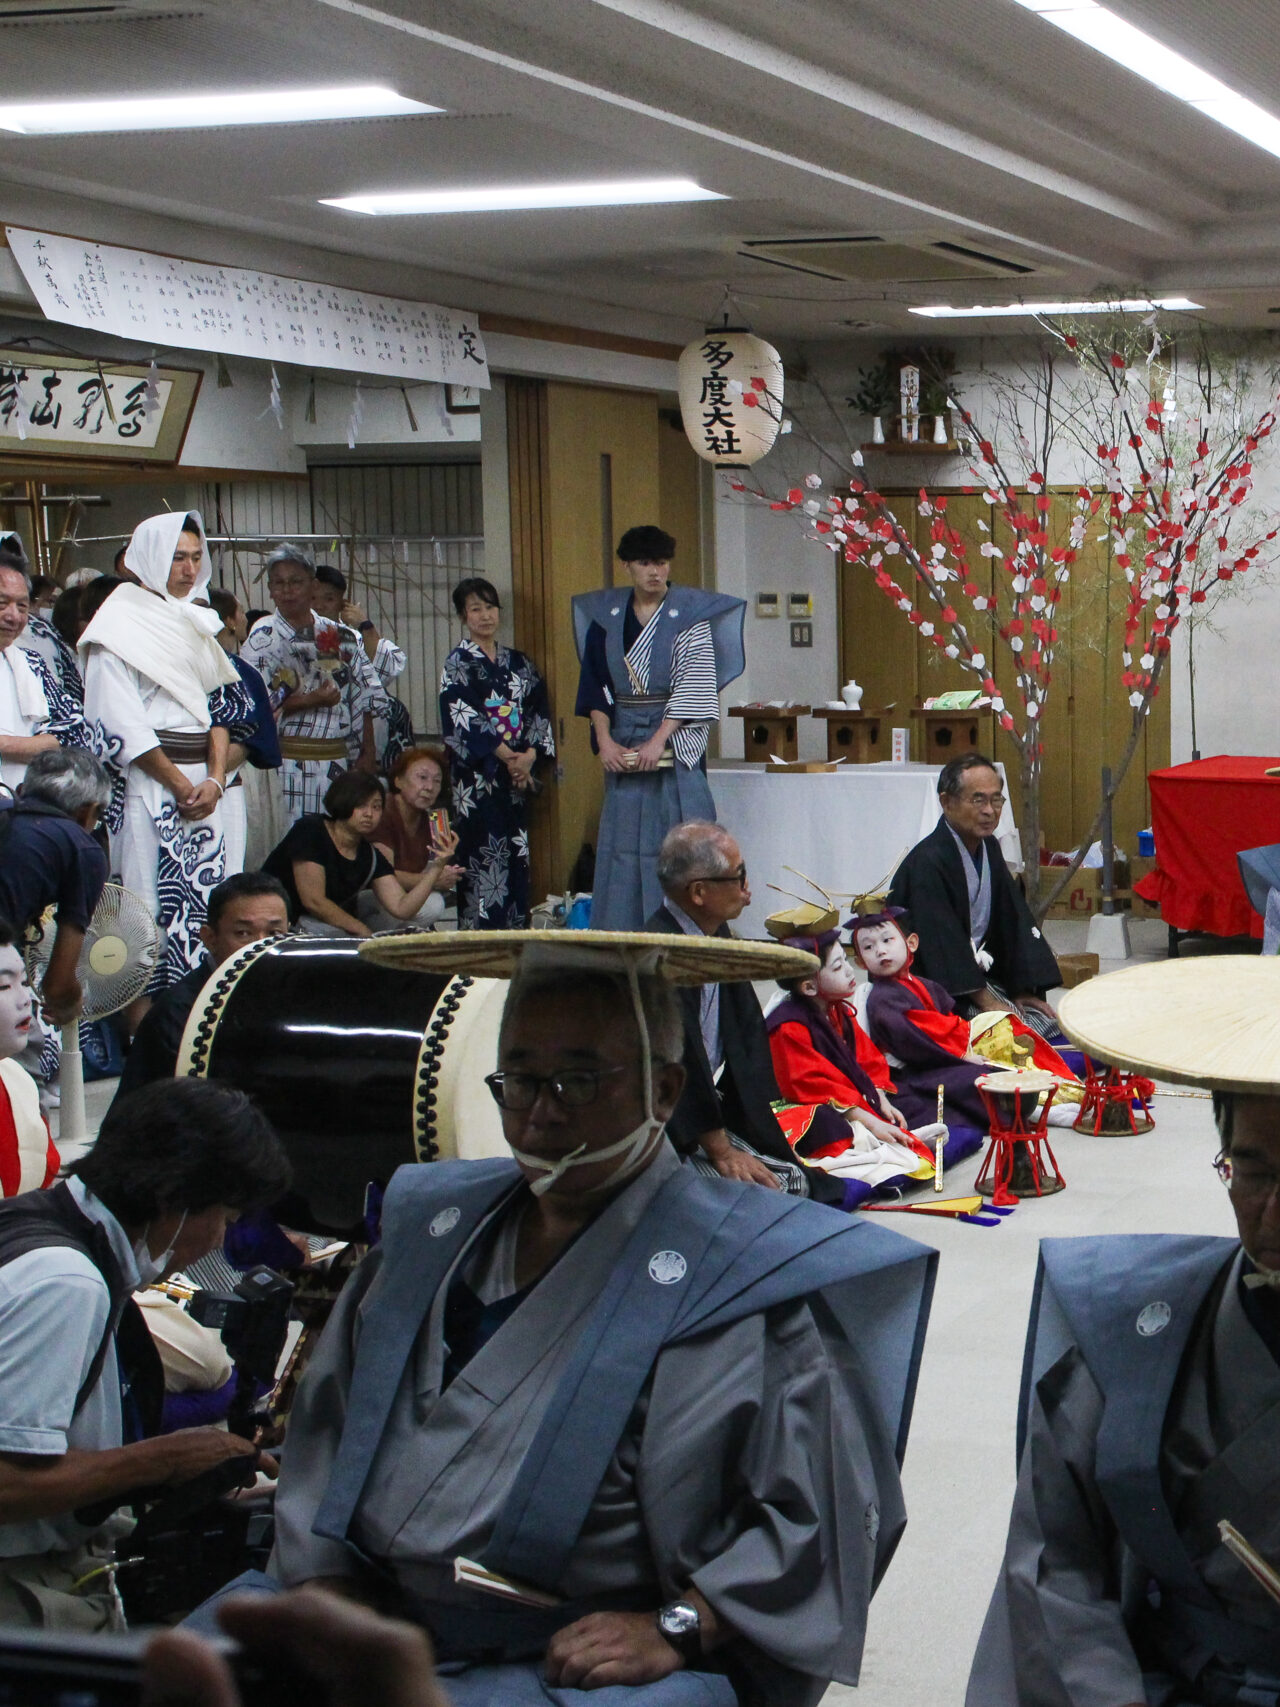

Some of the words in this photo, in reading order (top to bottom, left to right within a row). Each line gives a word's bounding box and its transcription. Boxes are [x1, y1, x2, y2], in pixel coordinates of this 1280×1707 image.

[458, 323, 485, 365] 定
[699, 340, 742, 456] 多度大社
